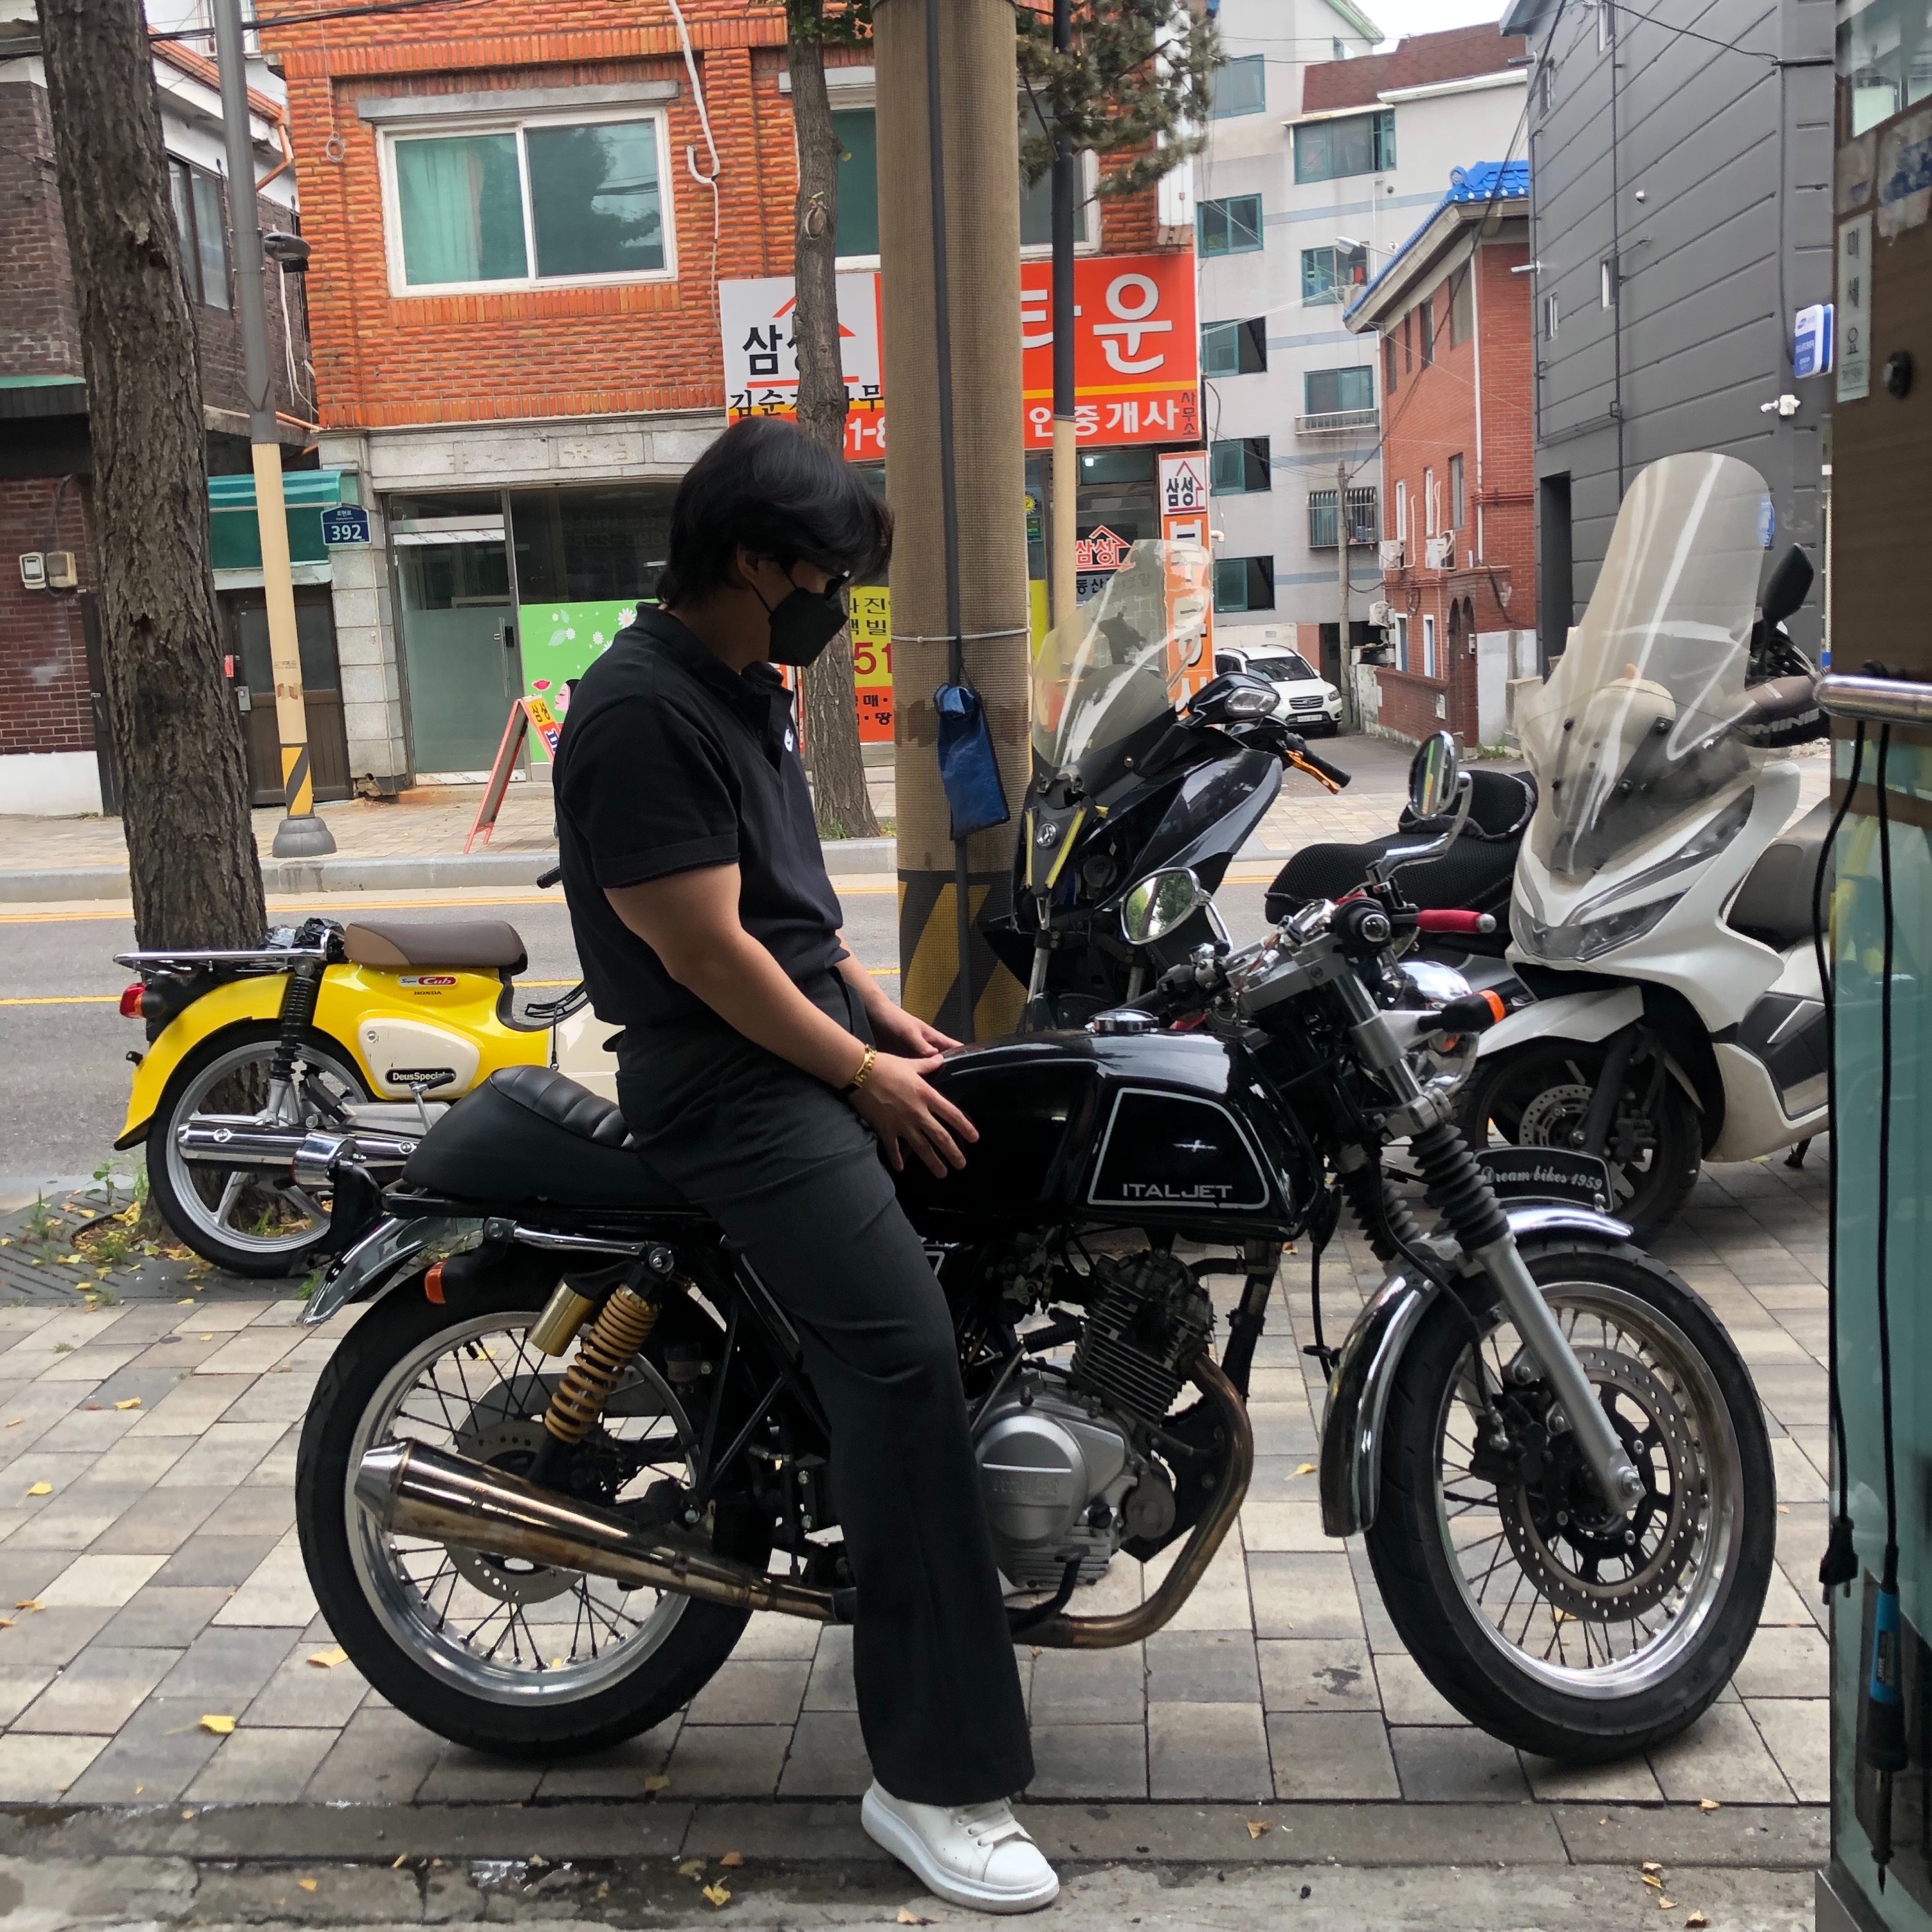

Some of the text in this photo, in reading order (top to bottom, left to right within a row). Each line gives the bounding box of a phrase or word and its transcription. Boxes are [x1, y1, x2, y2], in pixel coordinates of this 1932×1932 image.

[742, 324, 800, 376] 삼
[1181, 392, 1197, 435] 사무소
[1166, 477, 1194, 507] 삼성
[331, 525, 362, 541] 392
[1076, 539, 1114, 565] 삼성
[1122, 1183, 1233, 1199] ITALJET
[1533, 1165, 1568, 1184] bikes
[1570, 1173, 1603, 1191] 1959
